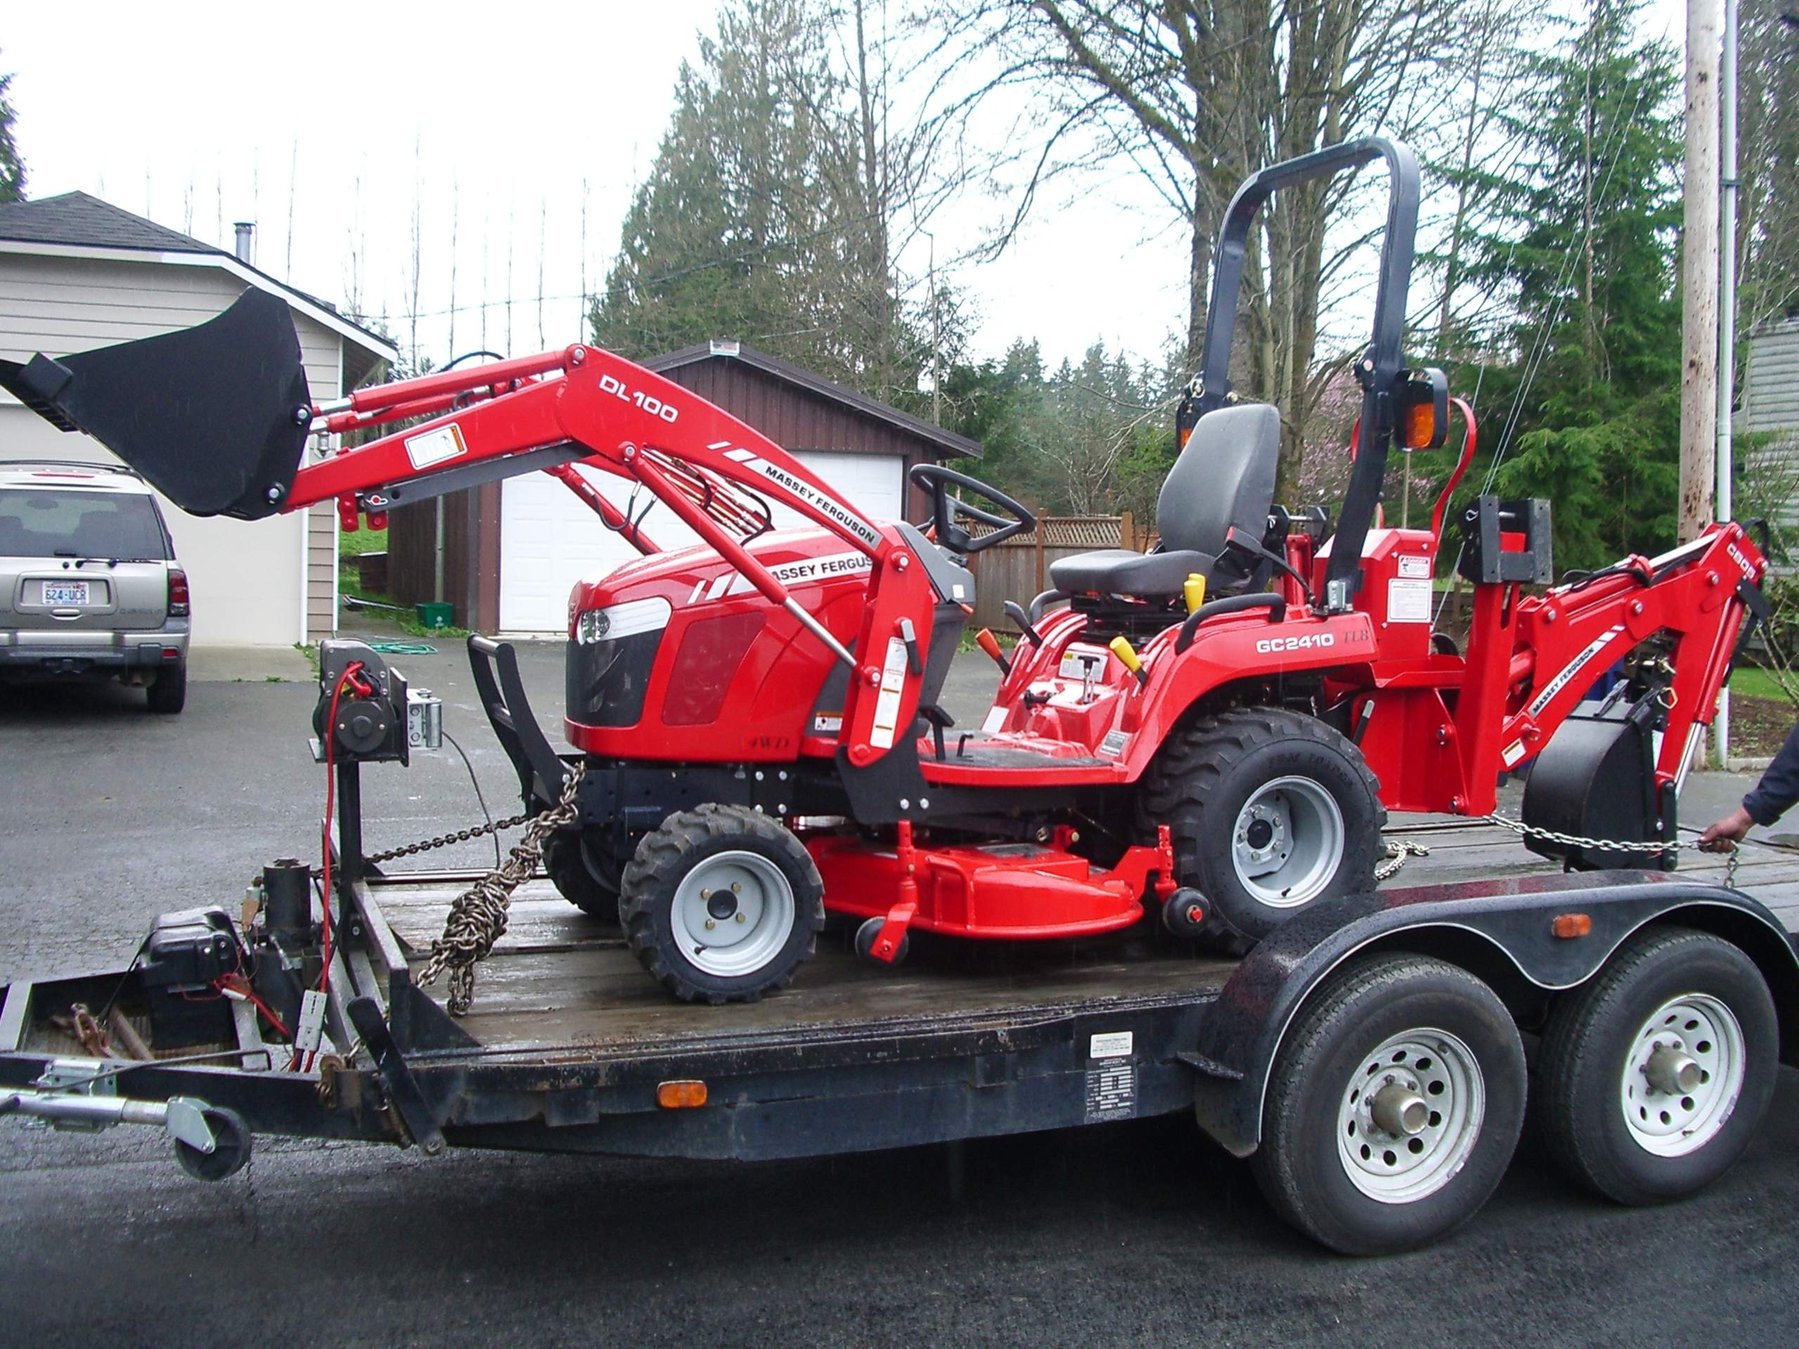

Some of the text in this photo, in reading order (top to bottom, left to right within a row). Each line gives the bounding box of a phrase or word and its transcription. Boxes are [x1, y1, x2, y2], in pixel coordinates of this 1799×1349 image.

[765, 466, 875, 543] MASSEY FERGUSON
[771, 556, 873, 581] ASSEY FERGUS
[1256, 633, 1334, 653] GC2410
[1533, 647, 1595, 713] MASSEY FERGUSON
